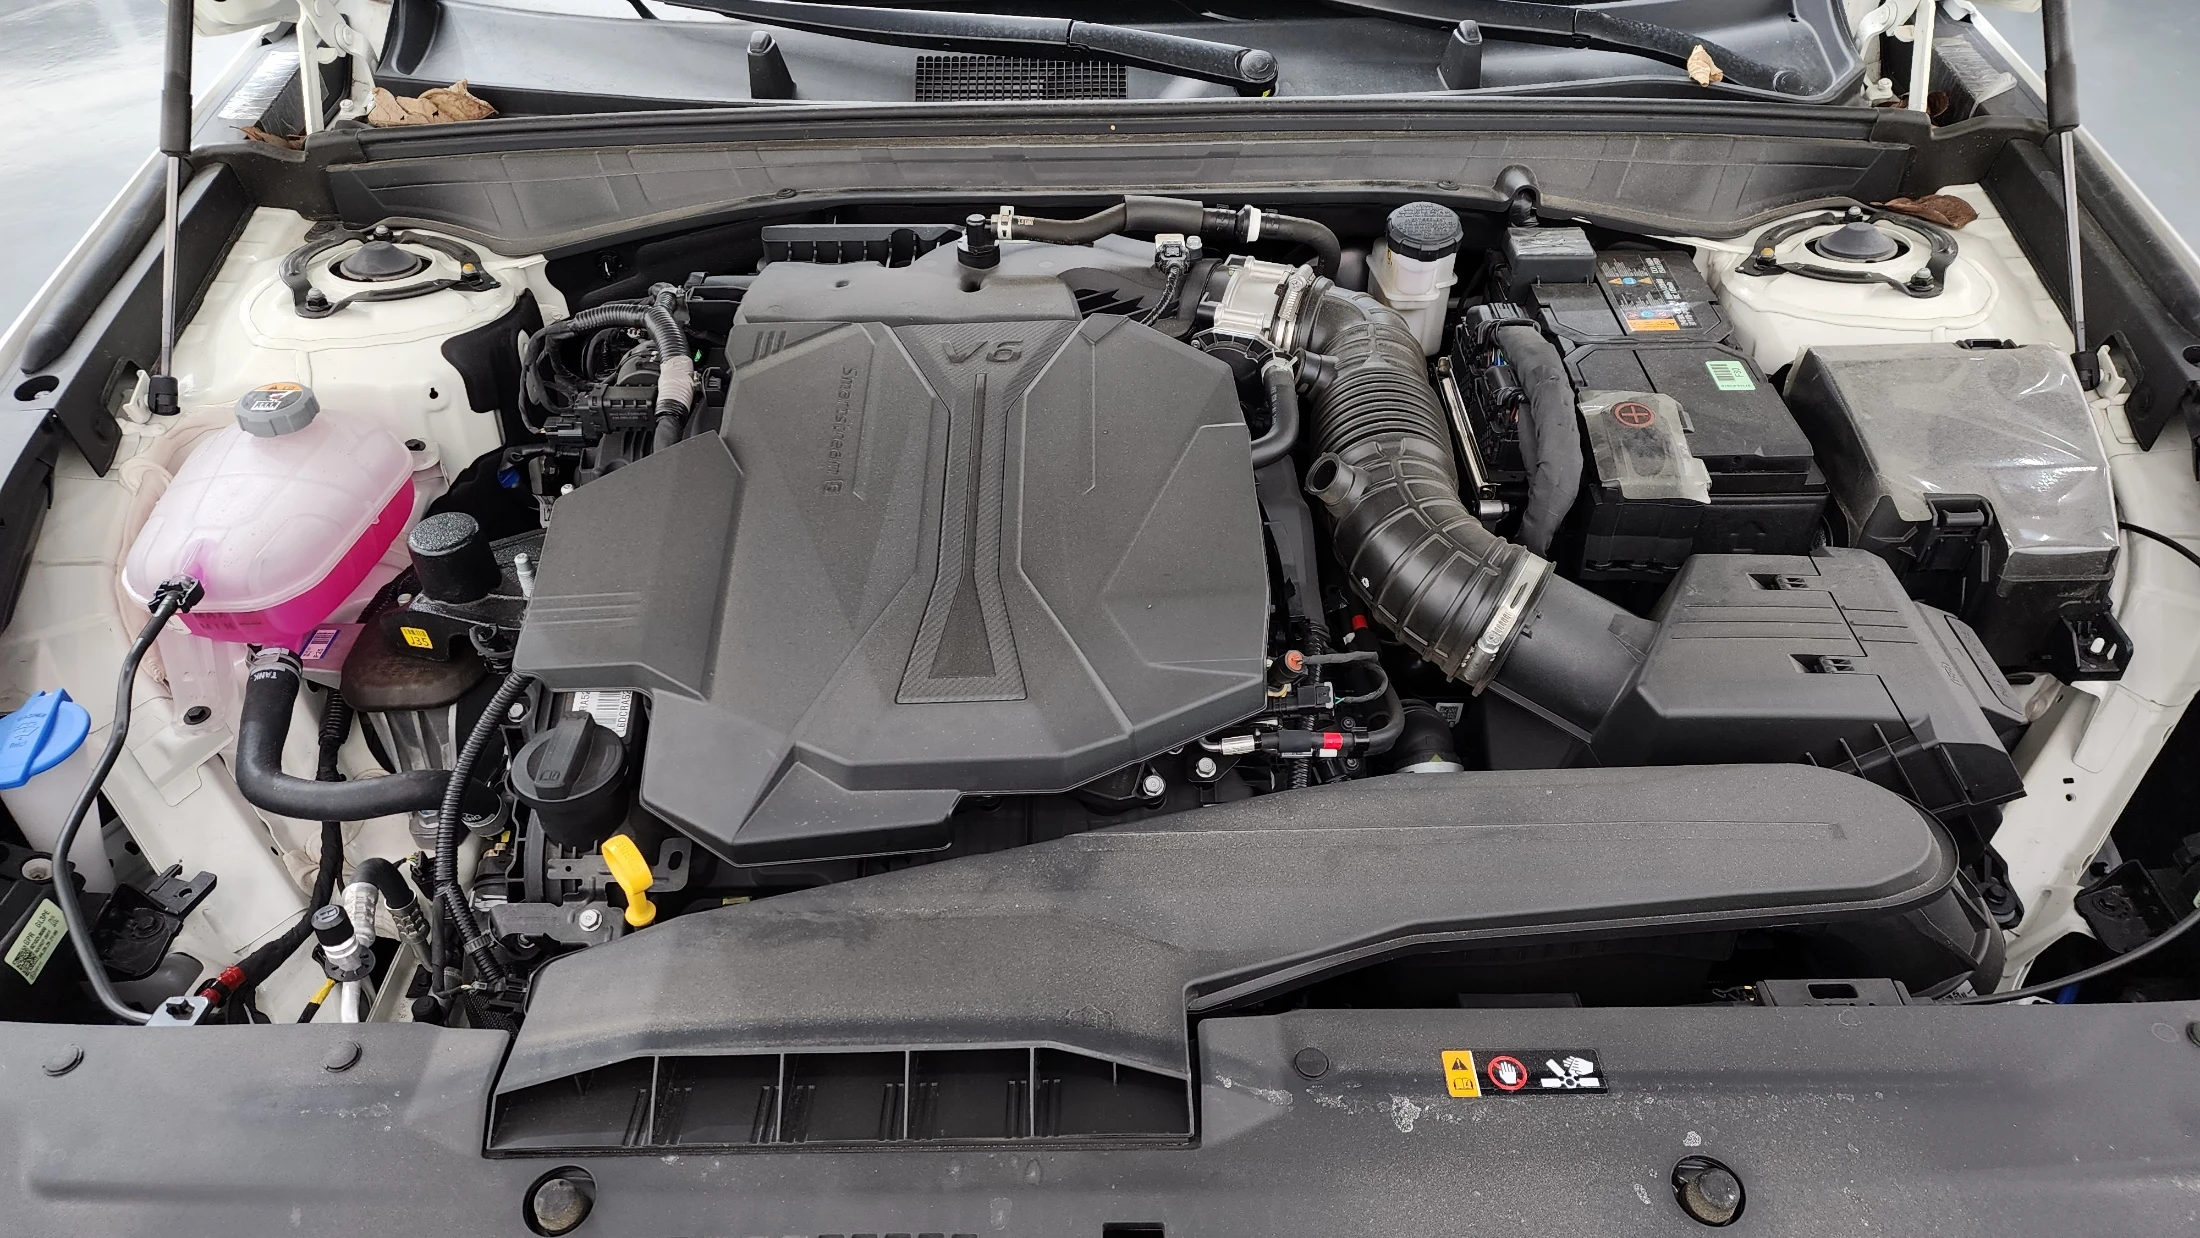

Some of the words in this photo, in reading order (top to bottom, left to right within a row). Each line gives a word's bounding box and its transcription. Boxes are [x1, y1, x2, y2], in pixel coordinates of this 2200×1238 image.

[940, 339, 1024, 363] V6
[826, 365, 857, 475] Smartstream
[254, 671, 277, 681] TANK
